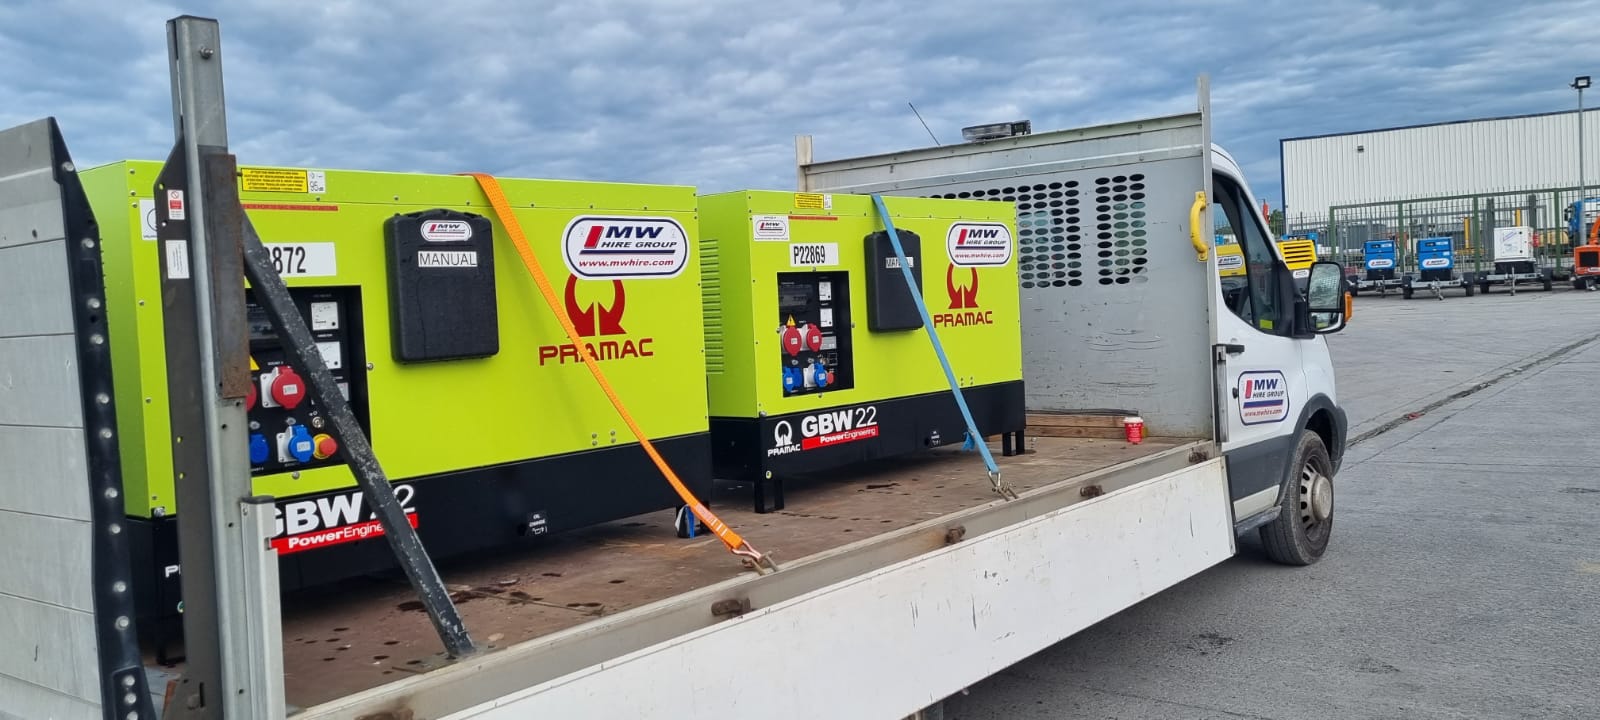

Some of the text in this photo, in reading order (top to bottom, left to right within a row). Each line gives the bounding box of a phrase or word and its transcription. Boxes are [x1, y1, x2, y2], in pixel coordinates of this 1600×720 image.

[605, 226, 664, 238] MW
[968, 229, 999, 238] MW
[419, 252, 477, 266] MANUAL
[793, 245, 826, 264] P22869
[579, 259, 674, 267] www.mwhire.com
[934, 311, 993, 328] PRAMAC
[538, 338, 654, 366] PRAMAC
[1254, 378, 1279, 390] MW
[801, 406, 878, 438] GBW 22
[820, 428, 876, 444] PowerEngineering
[767, 443, 801, 457] PRAMAC
[273, 492, 363, 536] BW
[288, 522, 384, 549] PowerEngine
